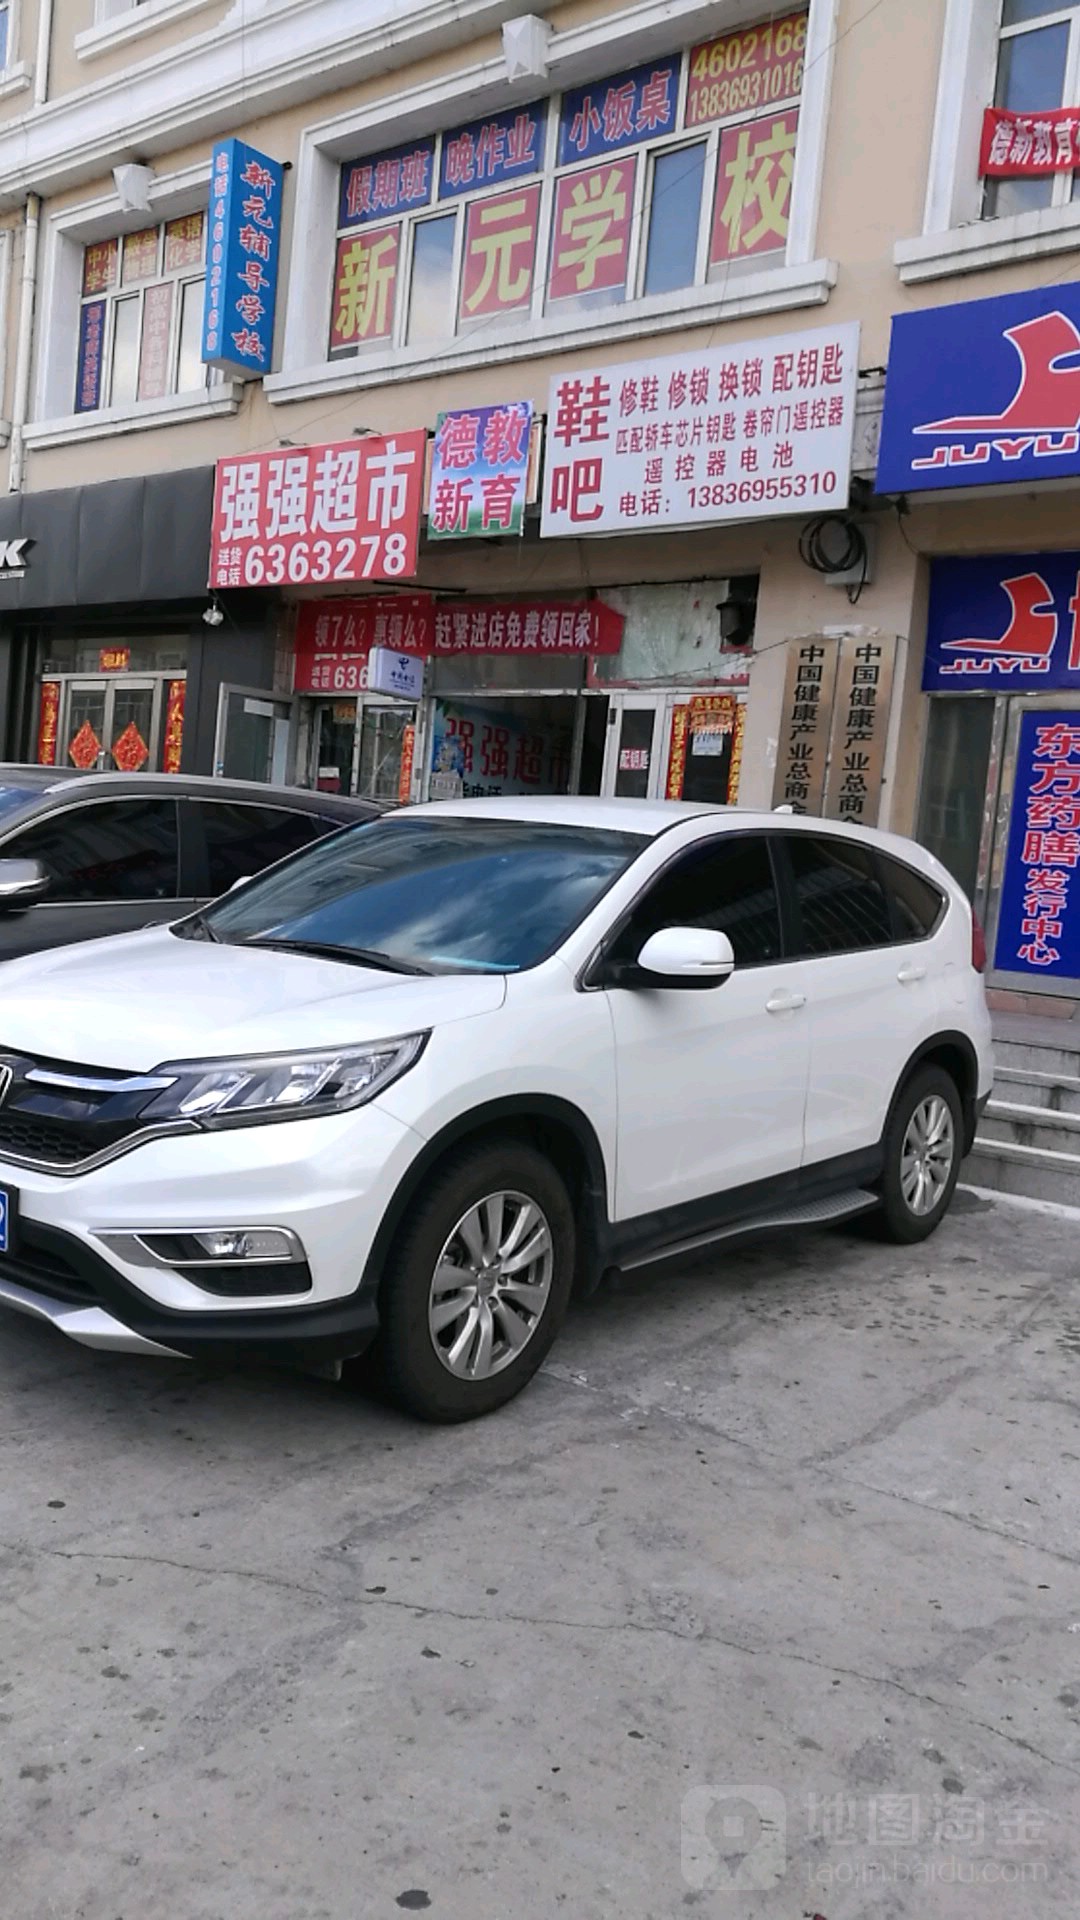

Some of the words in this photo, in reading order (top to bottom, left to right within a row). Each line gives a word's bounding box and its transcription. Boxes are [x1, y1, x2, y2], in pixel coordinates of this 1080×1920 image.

[692, 17, 808, 82] 4602168
[690, 58, 803, 122] 13836931016
[346, 150, 431, 216] 假期班
[445, 114, 535, 186] 晚作业
[569, 69, 672, 151] 小饭桌
[988, 117, 1080, 166] 德新教育
[335, 120, 796, 340] 新元学校
[231, 160, 276, 362] 新元辅导学校
[619, 374, 659, 418] 修鞋
[668, 366, 709, 411] 修锁
[719, 356, 763, 402] 换锁
[771, 342, 844, 394] 配钥匙
[549, 375, 611, 523] 鞋吧
[615, 411, 736, 455] 匹配轿车芯片钥匙
[743, 396, 844, 438] 卷帘门遥控器
[911, 431, 1080, 470] JUYU
[219, 440, 416, 544] 强强超市
[644, 441, 794, 485] 遥控器电池
[619, 489, 670, 518] 电话：
[687, 470, 837, 509] 13836955310
[244, 532, 407, 586] 6363278
[435, 608, 600, 649] 赶紧进店免费领回家！
[939, 657, 1050, 674] JUYU
